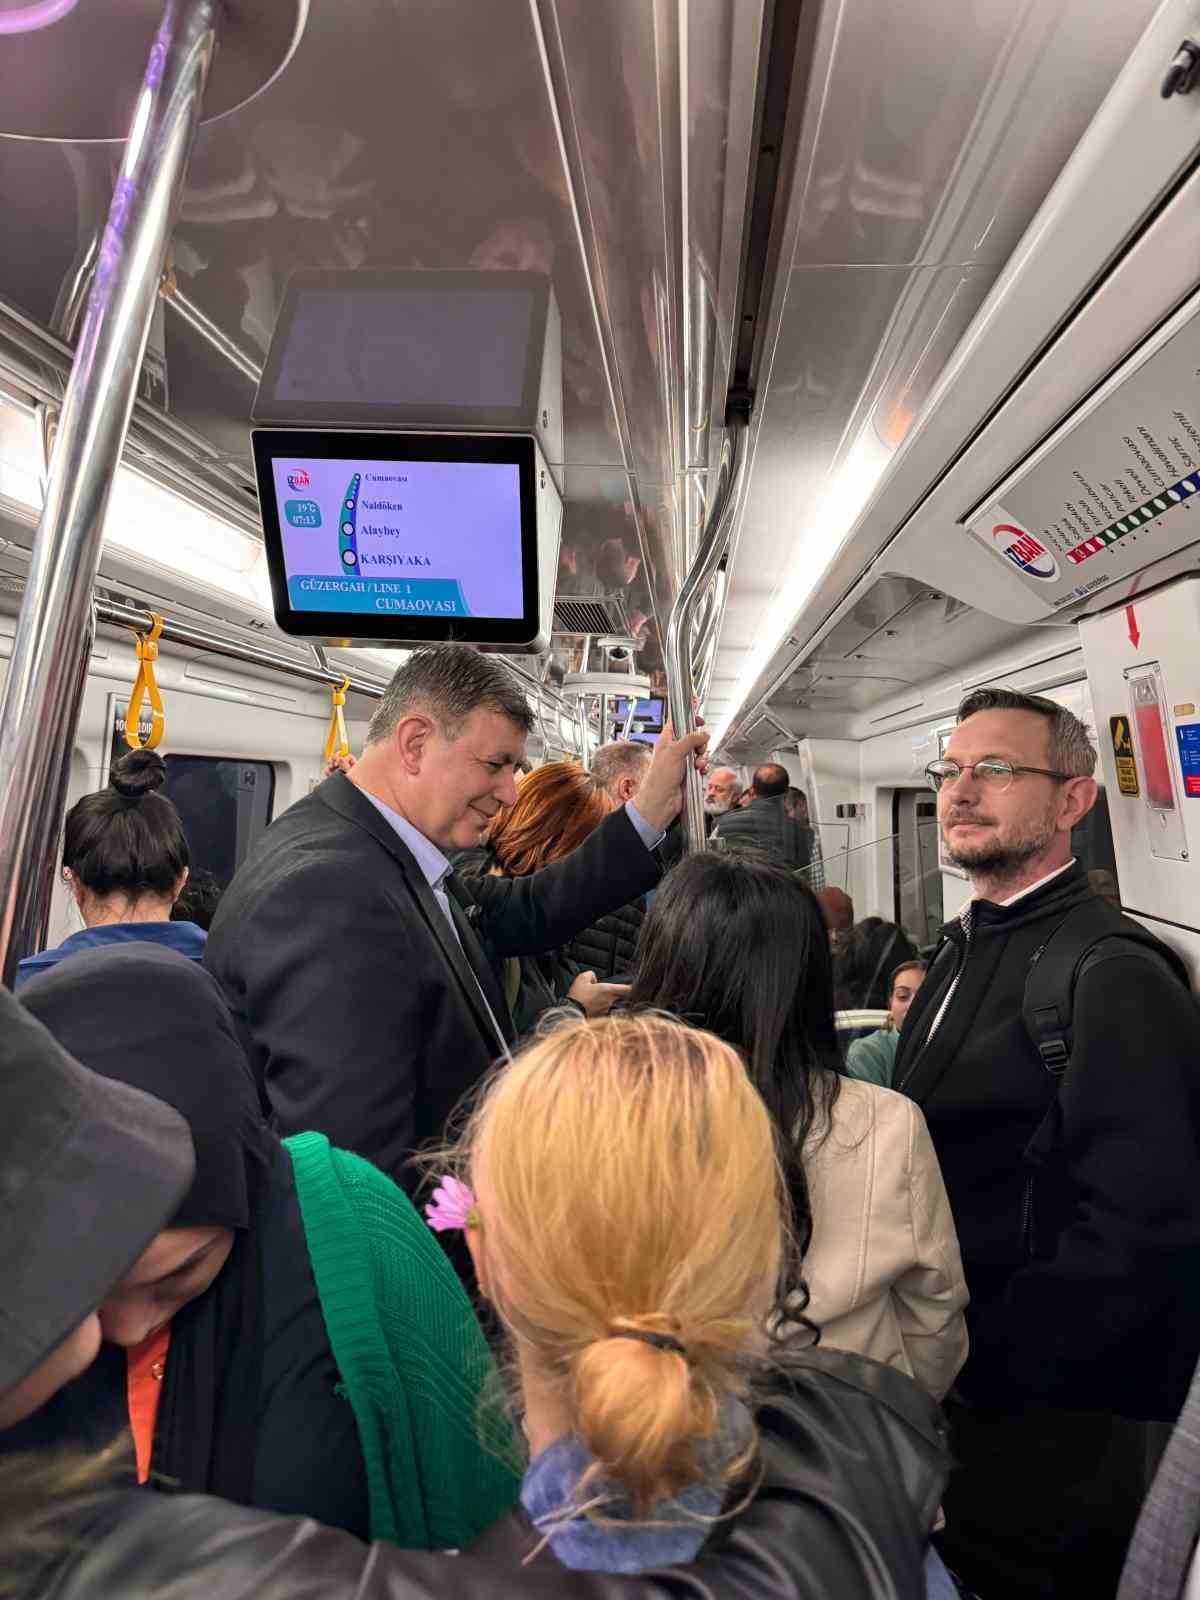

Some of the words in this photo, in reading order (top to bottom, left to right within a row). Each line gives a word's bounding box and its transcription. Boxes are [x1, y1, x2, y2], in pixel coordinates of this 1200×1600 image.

[361, 500, 403, 511] Naldöken
[361, 525, 400, 538] Alaybey
[361, 553, 431, 567] KARŞIYAKA
[374, 583, 401, 594] LINE
